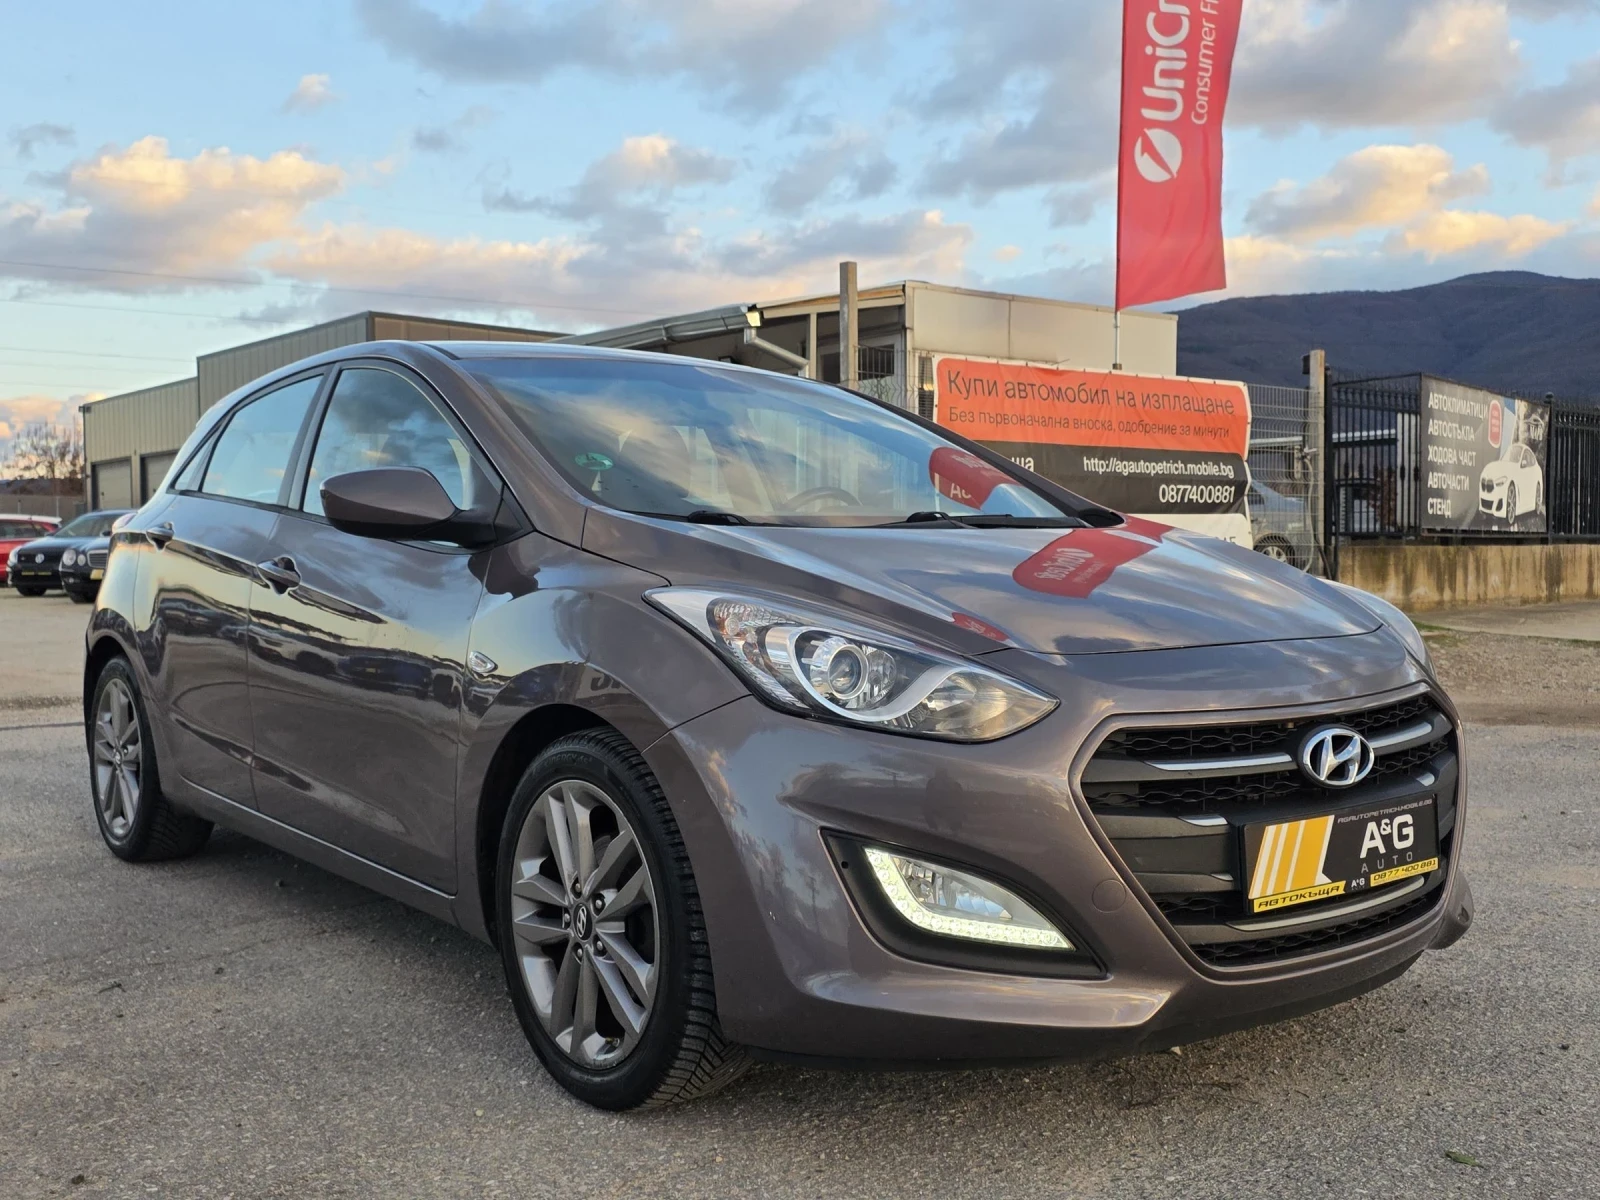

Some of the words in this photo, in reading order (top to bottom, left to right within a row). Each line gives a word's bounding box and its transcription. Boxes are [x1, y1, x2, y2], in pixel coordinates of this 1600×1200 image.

[1191, 18, 1216, 125] Consumer
[948, 370, 999, 400] Купи
[1004, 381, 1111, 406] автомобил
[1116, 389, 1137, 408] на
[1141, 392, 1235, 416] изплащане
[1428, 391, 1488, 420] АВТОКЛИМАТИЦИ
[949, 406, 975, 422] Без
[979, 411, 1070, 429] първоначална
[1073, 418, 1115, 433] вноска,
[1118, 419, 1177, 436] одобрение
[1180, 424, 1190, 436] за
[1193, 426, 1229, 440] минути
[1428, 418, 1475, 442] АВТОСТЪКЛА
[1083, 456, 1235, 478] http://agautopetrich.mobile.bg
[1428, 445, 1458, 466] ХОДОВА
[1459, 449, 1476, 467] ЧАСТ
[1428, 471, 1470, 491] АВТОЧАСТИ
[1159, 484, 1235, 503] 0877400881
[1428, 497, 1452, 519] СТЕНД
[1360, 814, 1414, 859] A&G
[1361, 852, 1413, 873] AUTO
[1373, 868, 1400, 881] 0877
[1401, 864, 1420, 874] 400
[1420, 859, 1436, 869] 881
[1257, 885, 1341, 909] АВТОКЪЩА
